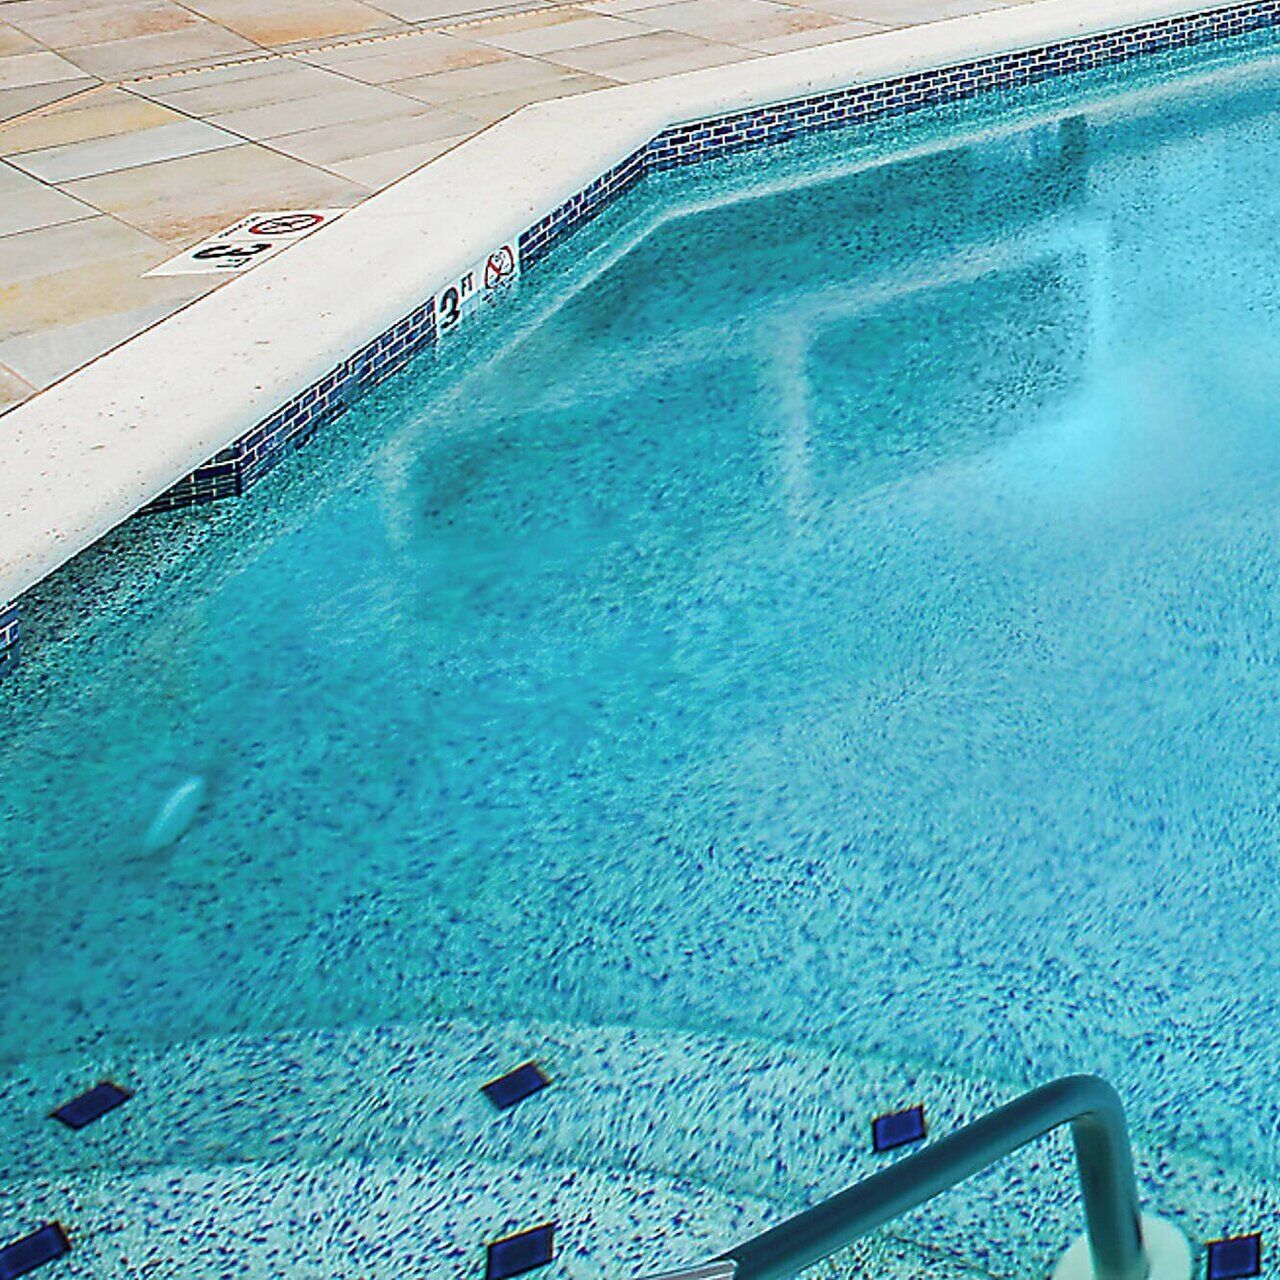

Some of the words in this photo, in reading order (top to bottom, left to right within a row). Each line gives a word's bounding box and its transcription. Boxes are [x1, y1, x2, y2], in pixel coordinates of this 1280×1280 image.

[192, 243, 273, 259] 3
[440, 287, 460, 329] 3
[461, 272, 473, 298] FT
